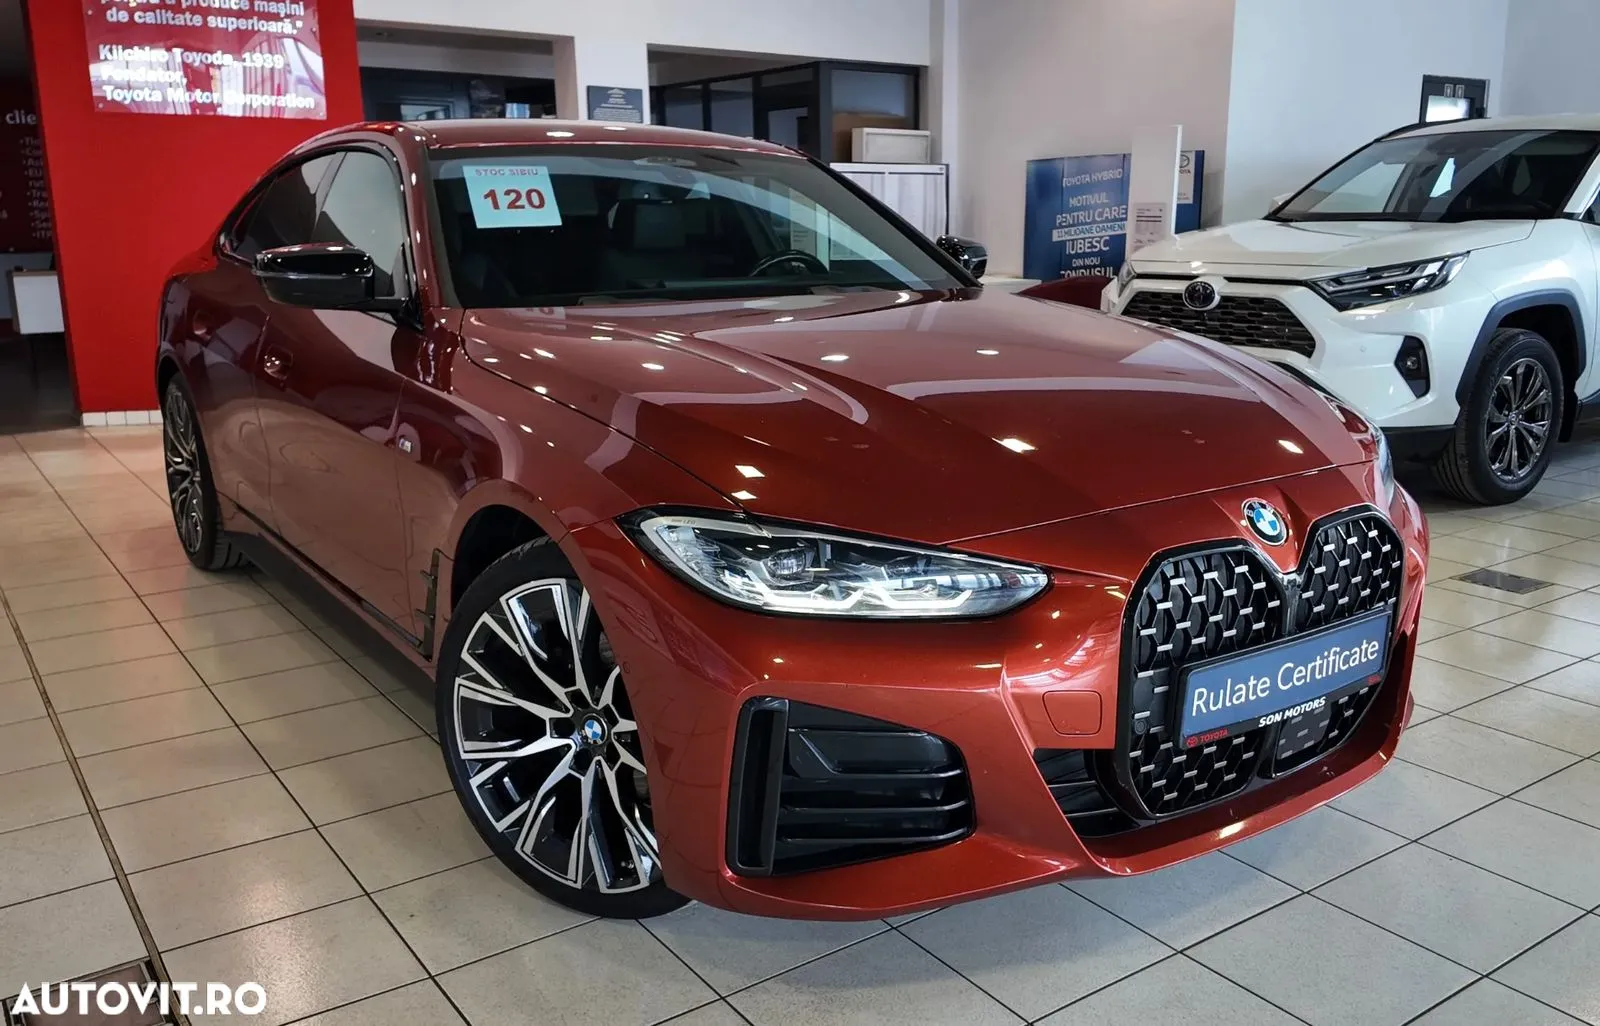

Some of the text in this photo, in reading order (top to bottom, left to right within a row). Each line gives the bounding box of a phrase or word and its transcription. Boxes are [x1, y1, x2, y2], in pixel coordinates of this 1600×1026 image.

[106, 6, 129, 22] de
[133, 9, 203, 27] calitate
[241, 51, 284, 69] 1939
[102, 85, 163, 104] Toyota
[166, 87, 221, 104] Motor
[475, 168, 539, 177] STOC SIBIU
[1063, 168, 1123, 188] TOYOTA HYBRID
[483, 188, 546, 211] 120
[1069, 192, 1109, 208] MOTIVUL
[1056, 204, 1127, 227] PENTRU CARE
[1066, 236, 1110, 254] IUBESC
[1072, 257, 1100, 267] DIN NOU
[1191, 639, 1379, 716] Rulate Certificate
[1258, 696, 1327, 728] SON MOTORS
[1200, 729, 1228, 742] TOYOTA
